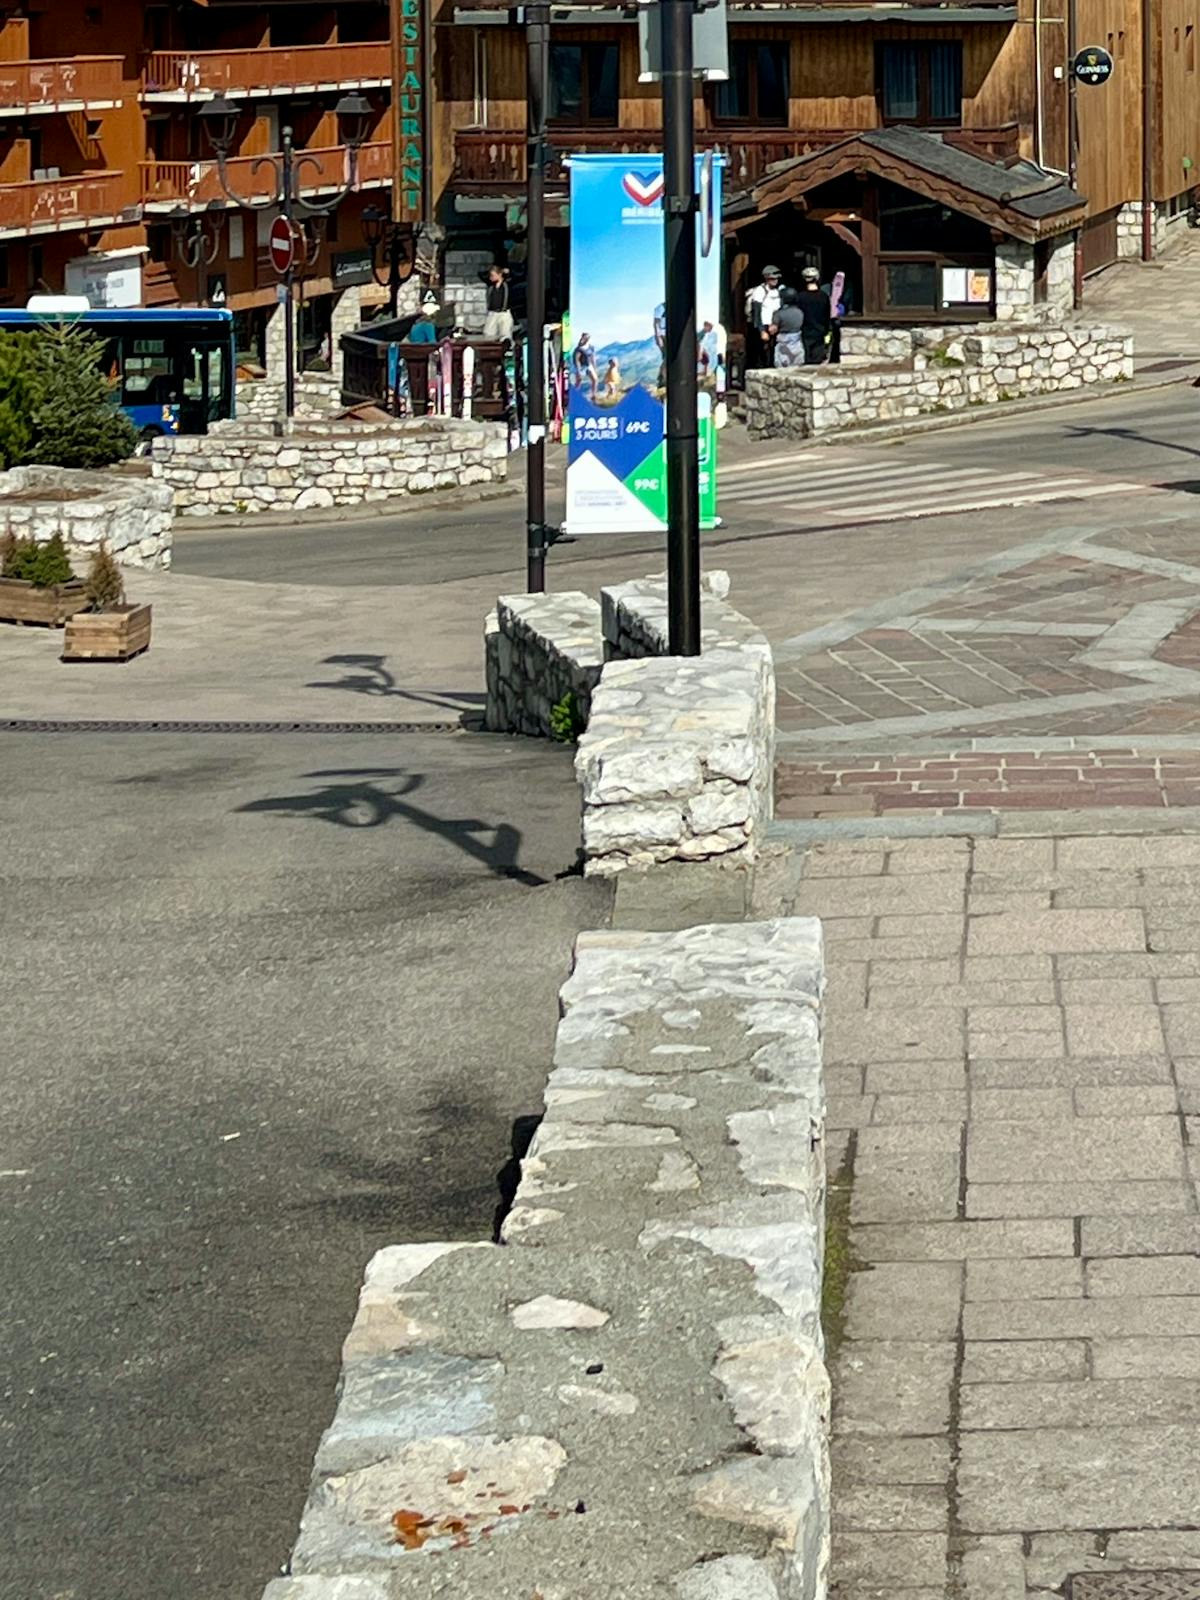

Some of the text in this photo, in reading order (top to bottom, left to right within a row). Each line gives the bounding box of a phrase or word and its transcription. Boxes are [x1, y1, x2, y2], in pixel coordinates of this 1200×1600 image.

[574, 417, 618, 430] PASS
[576, 430, 617, 440] 3 JOURS
[634, 479, 659, 491] 99€
